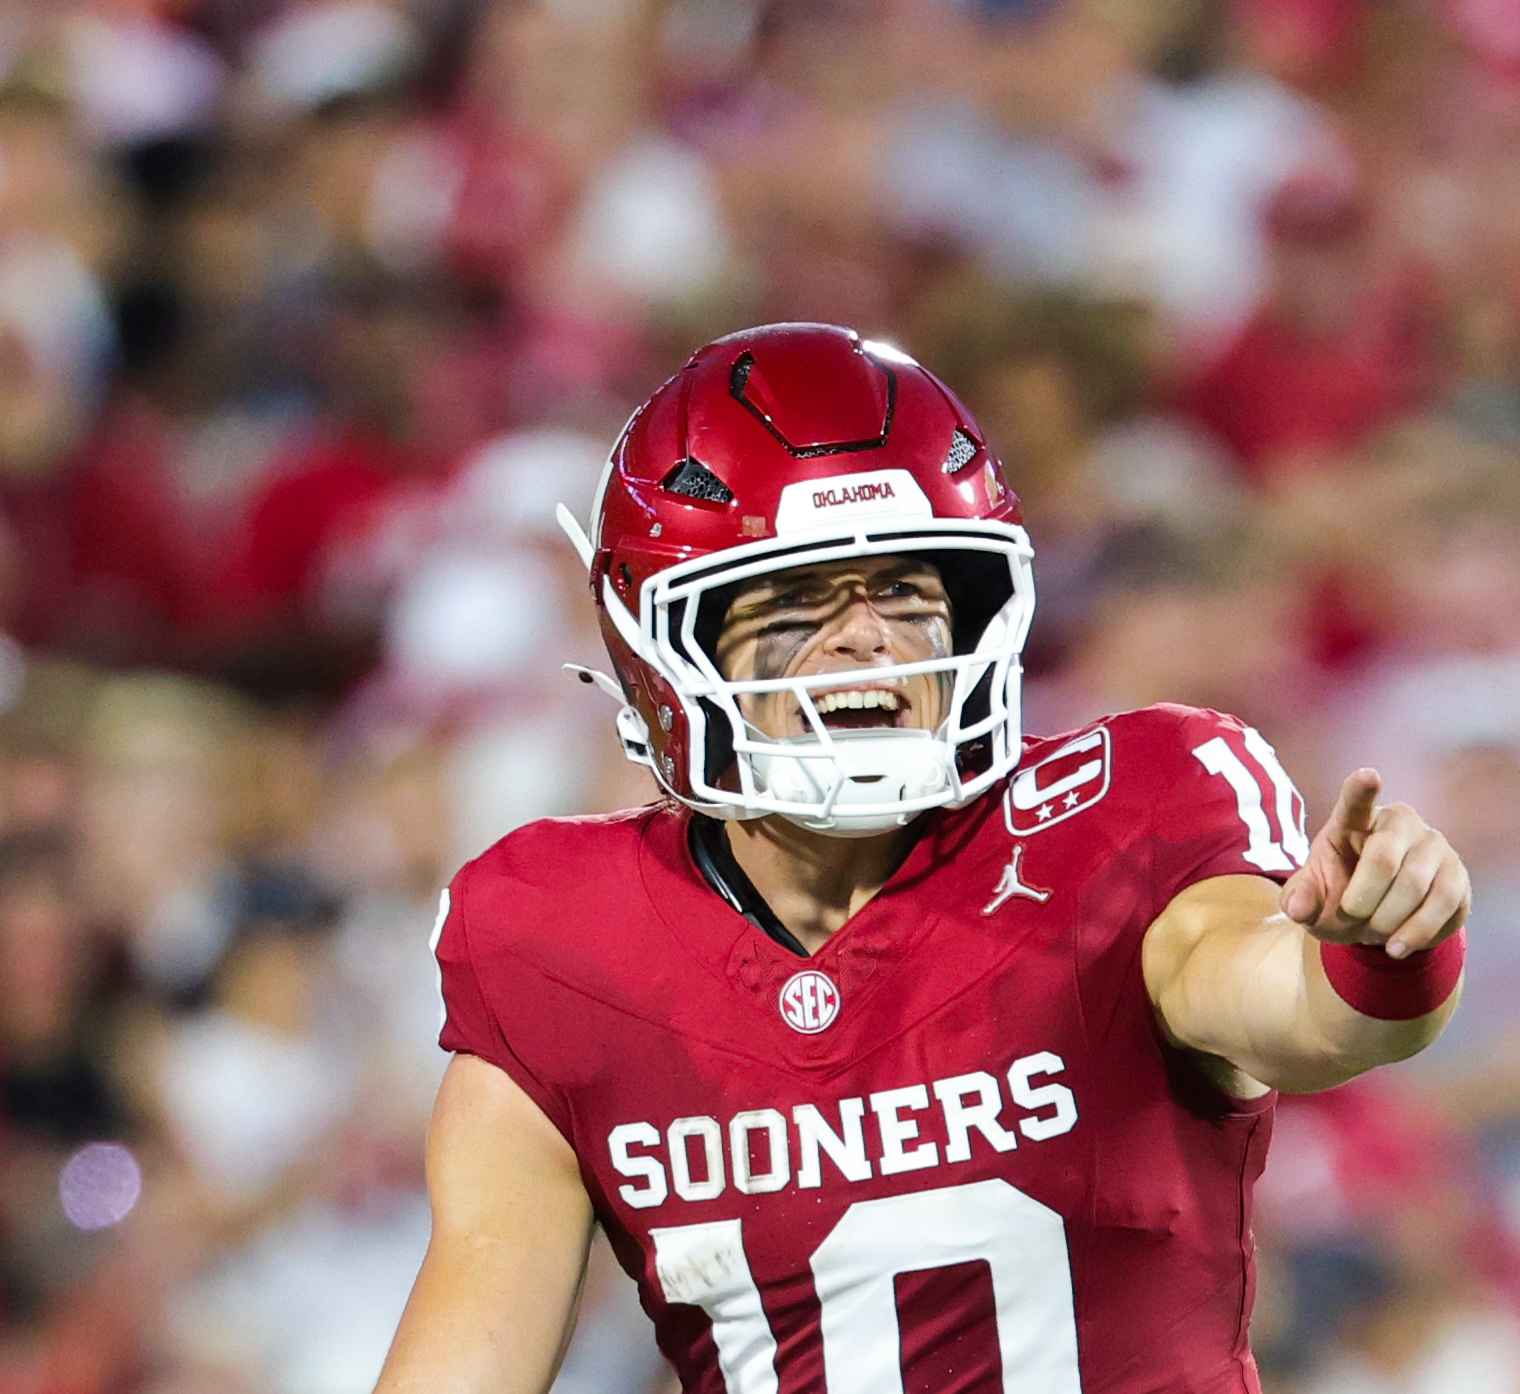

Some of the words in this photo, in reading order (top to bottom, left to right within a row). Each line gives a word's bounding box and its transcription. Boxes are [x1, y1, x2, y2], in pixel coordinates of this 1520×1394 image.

[812, 482, 896, 509] OKLAHOMA
[783, 975, 836, 1030] SEC
[608, 1050, 1078, 1209] SOONERS
